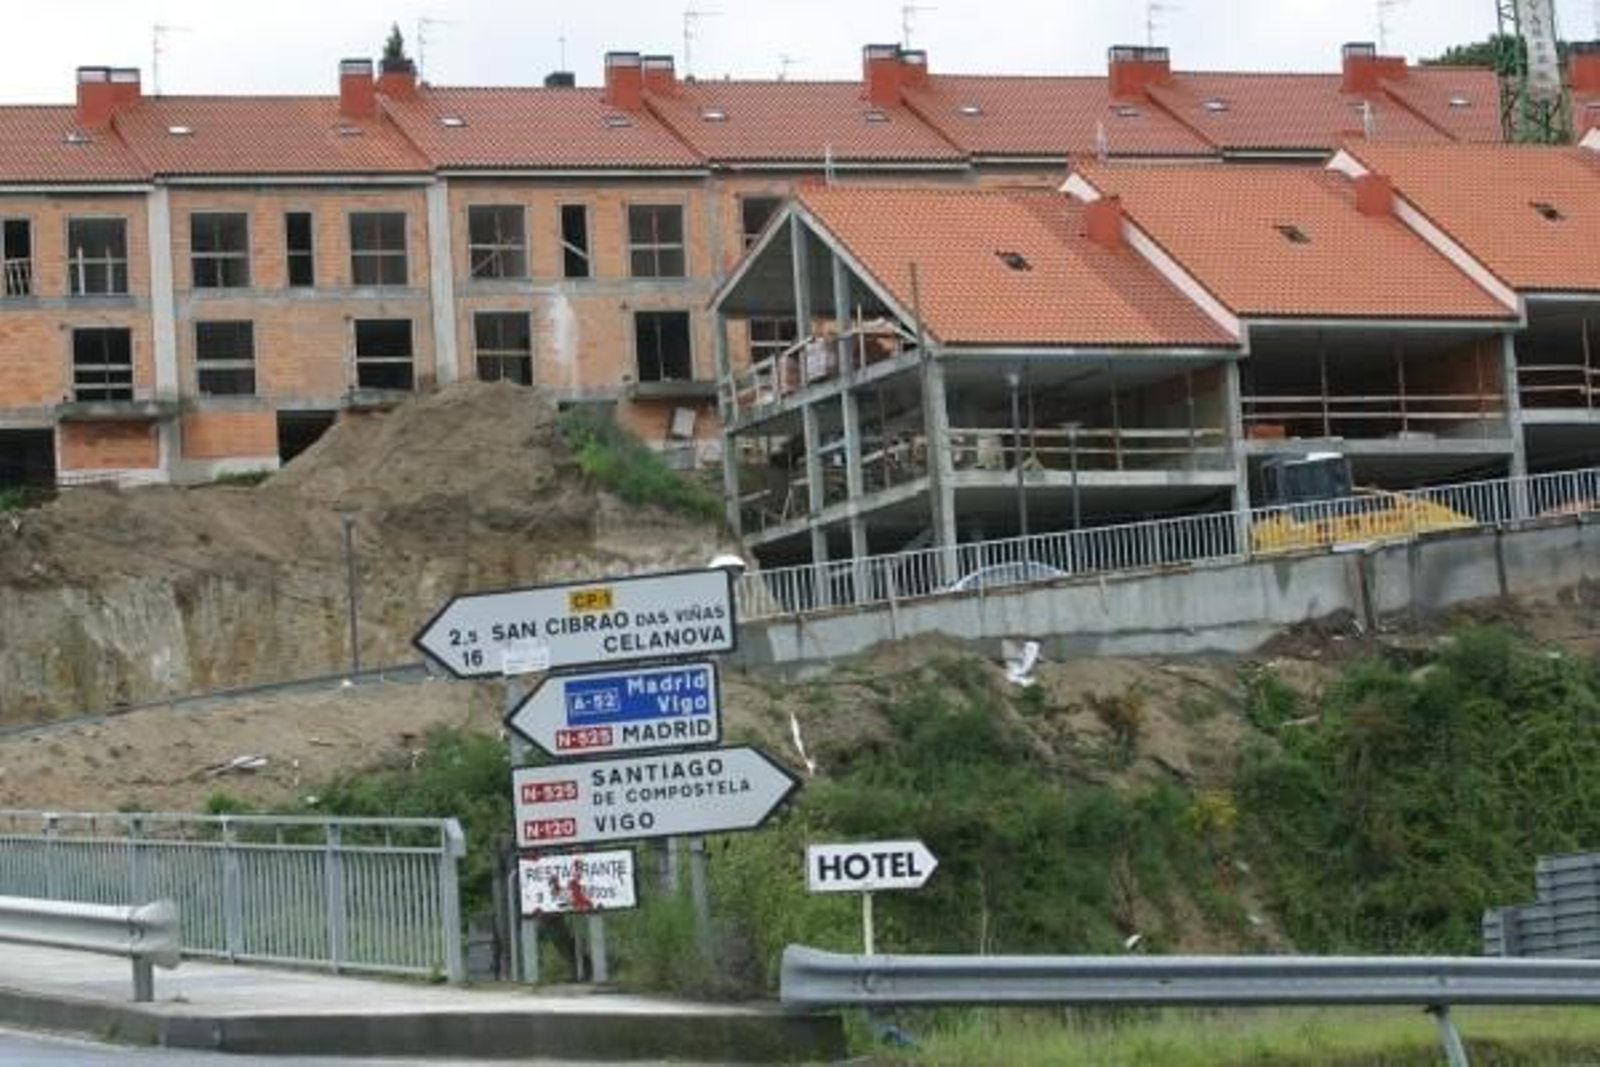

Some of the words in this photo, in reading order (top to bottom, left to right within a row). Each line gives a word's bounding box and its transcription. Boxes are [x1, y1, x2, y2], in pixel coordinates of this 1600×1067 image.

[492, 621, 536, 640] SAN
[545, 611, 629, 636] CIBRAO
[636, 612, 669, 627] DAS
[676, 604, 725, 621] VIÑAS
[463, 649, 483, 667] 16
[603, 625, 725, 653] CELANOVA
[627, 670, 707, 696] Madrid
[574, 693, 616, 710] A-52
[657, 694, 707, 715] Vigo
[622, 720, 712, 744] MADRID
[591, 758, 724, 787] SANTIAGO
[523, 783, 577, 802] N-525
[593, 791, 615, 806] DE
[625, 778, 751, 803] COMPOSTELA
[526, 821, 575, 840] N-120
[595, 812, 655, 832] VIGO
[526, 860, 627, 882] RESTARANTE
[818, 852, 922, 881] HOTEL
